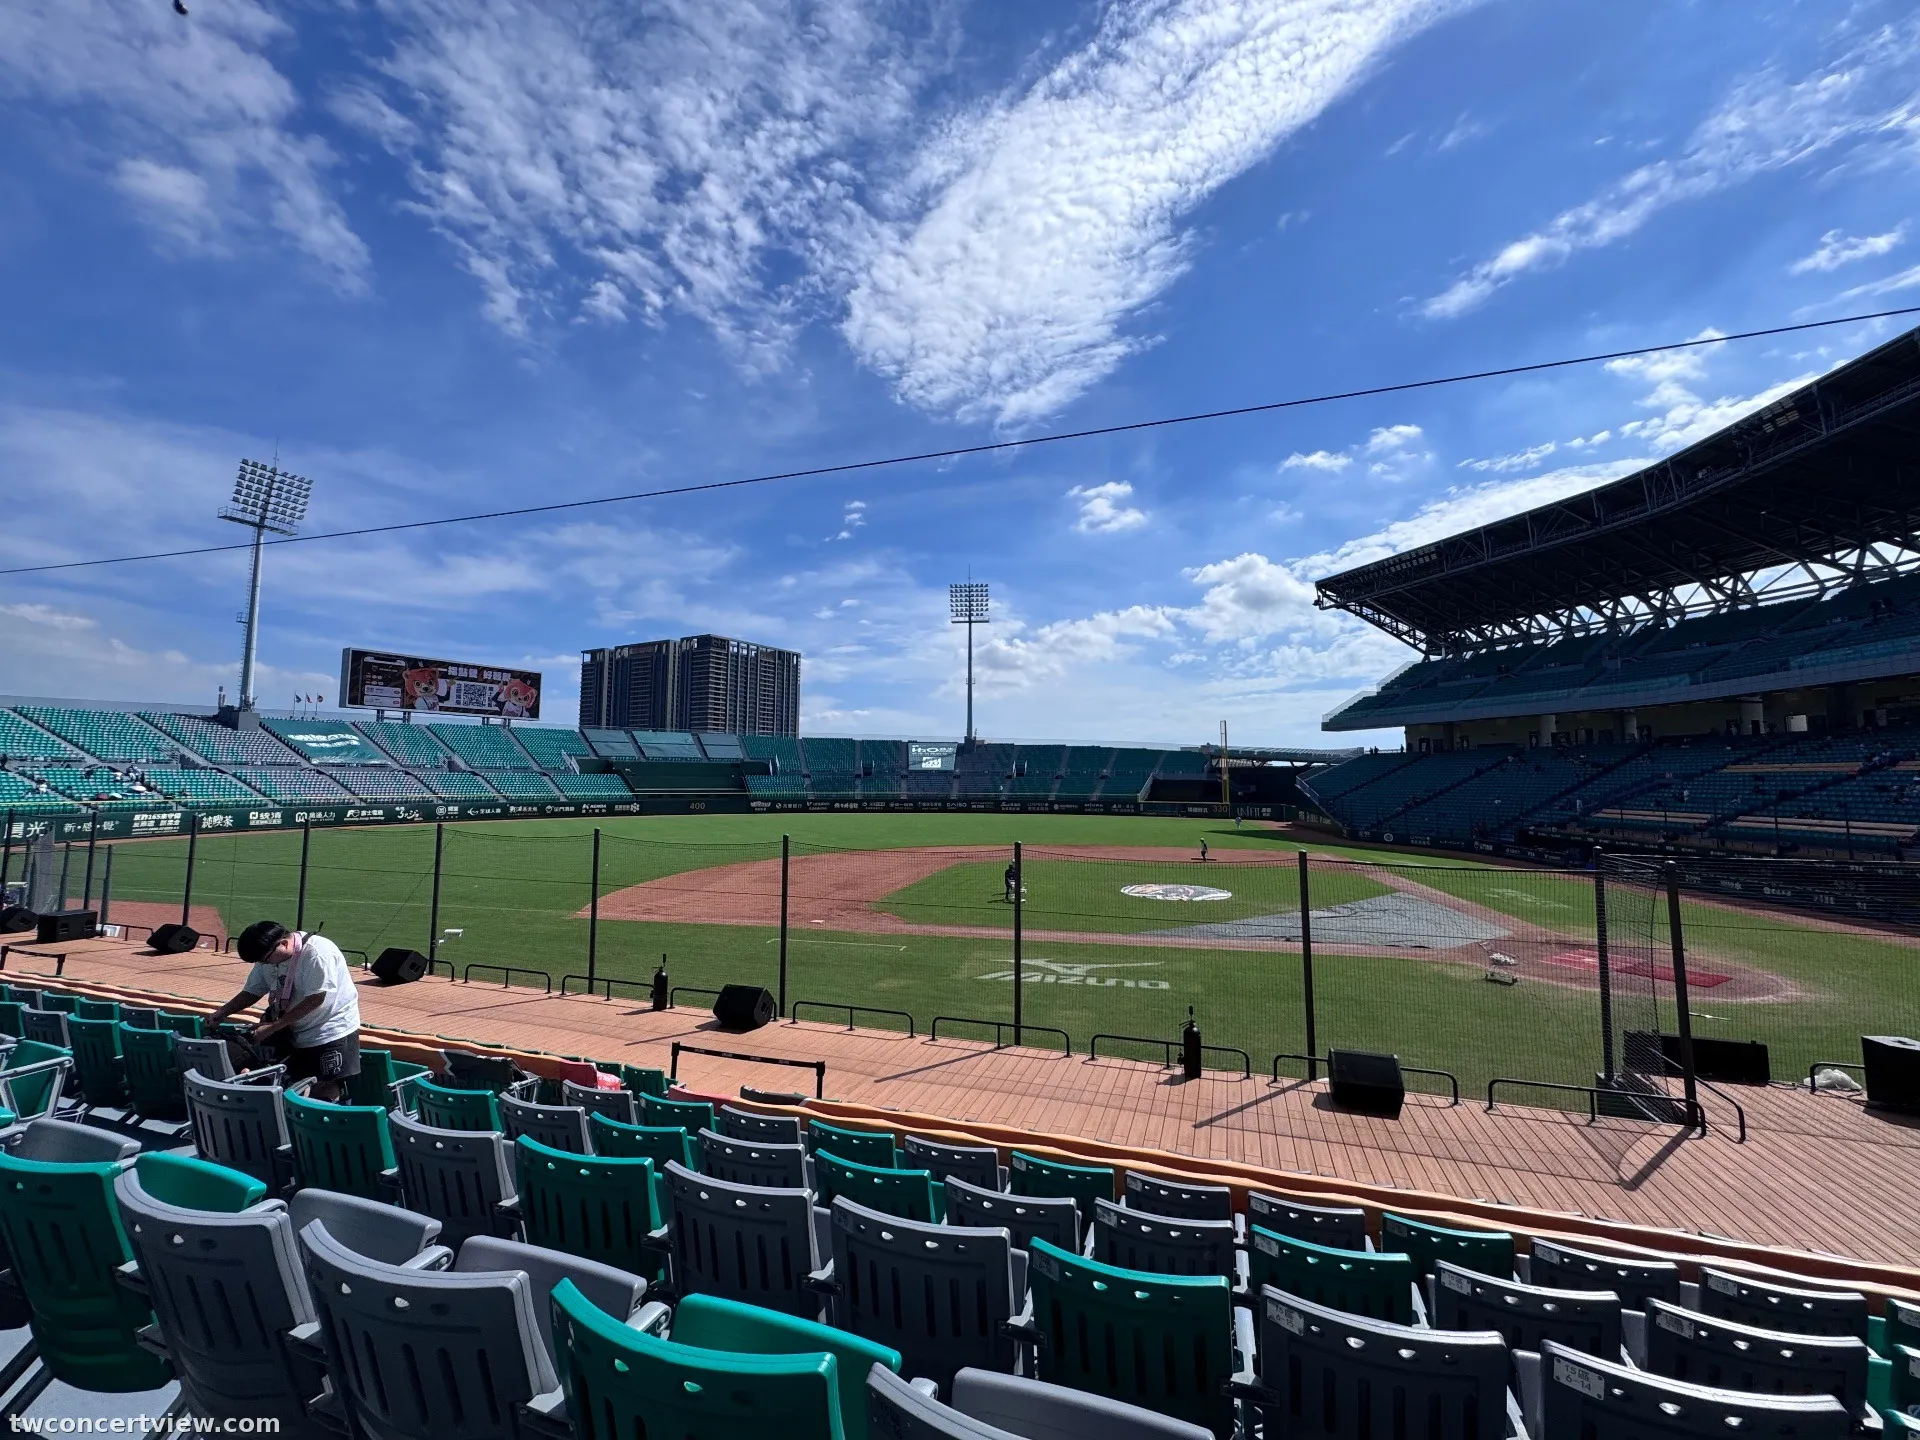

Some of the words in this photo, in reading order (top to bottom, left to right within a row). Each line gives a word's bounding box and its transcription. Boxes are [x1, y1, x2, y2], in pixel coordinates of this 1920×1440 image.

[690, 802, 706, 810] 400
[1212, 805, 1228, 813] 330
[1564, 1364, 1590, 1382] 15區
[1565, 1374, 1591, 1390] 6-14
